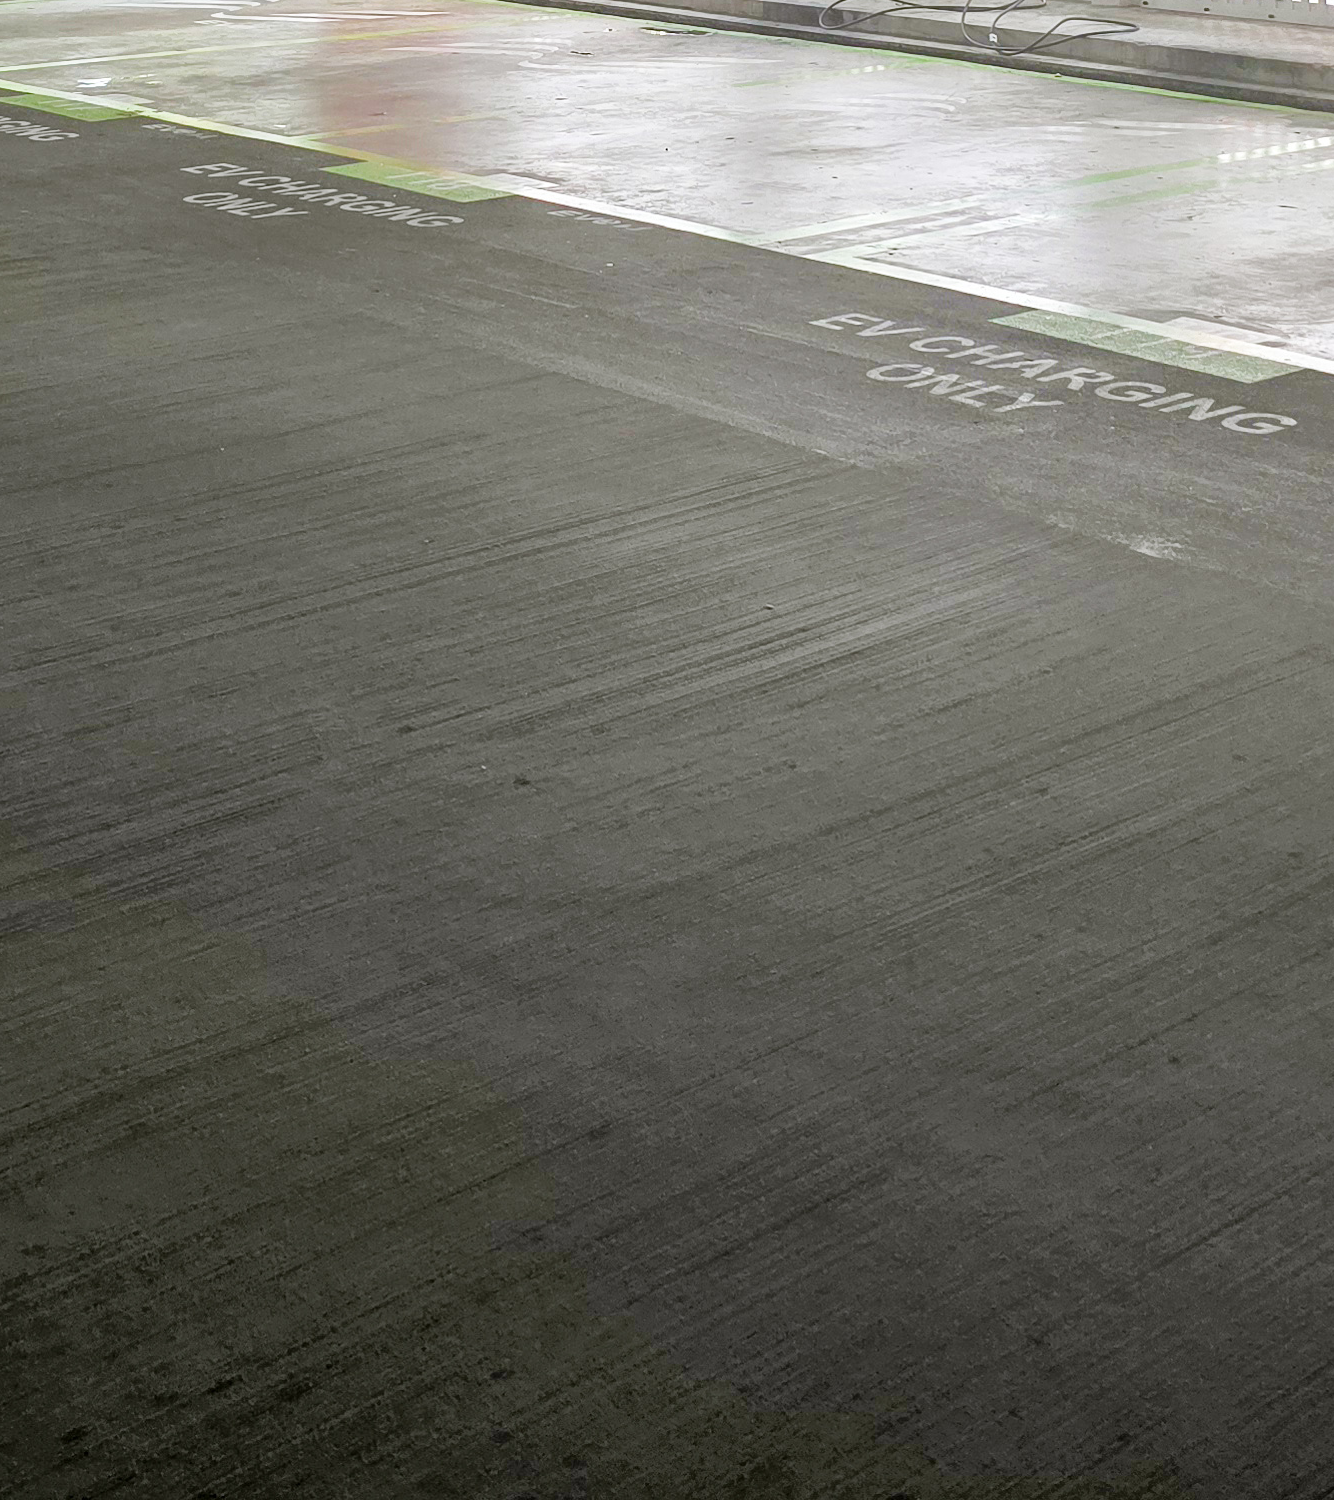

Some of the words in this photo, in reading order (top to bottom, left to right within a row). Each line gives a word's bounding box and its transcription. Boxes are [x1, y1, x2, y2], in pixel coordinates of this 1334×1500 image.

[180, 162, 265, 178] EV
[238, 176, 465, 227] CHARGING
[182, 192, 309, 219] ONLY
[807, 312, 922, 338] EV
[907, 335, 1299, 436] CHARGING
[866, 362, 1065, 415] ONLY
